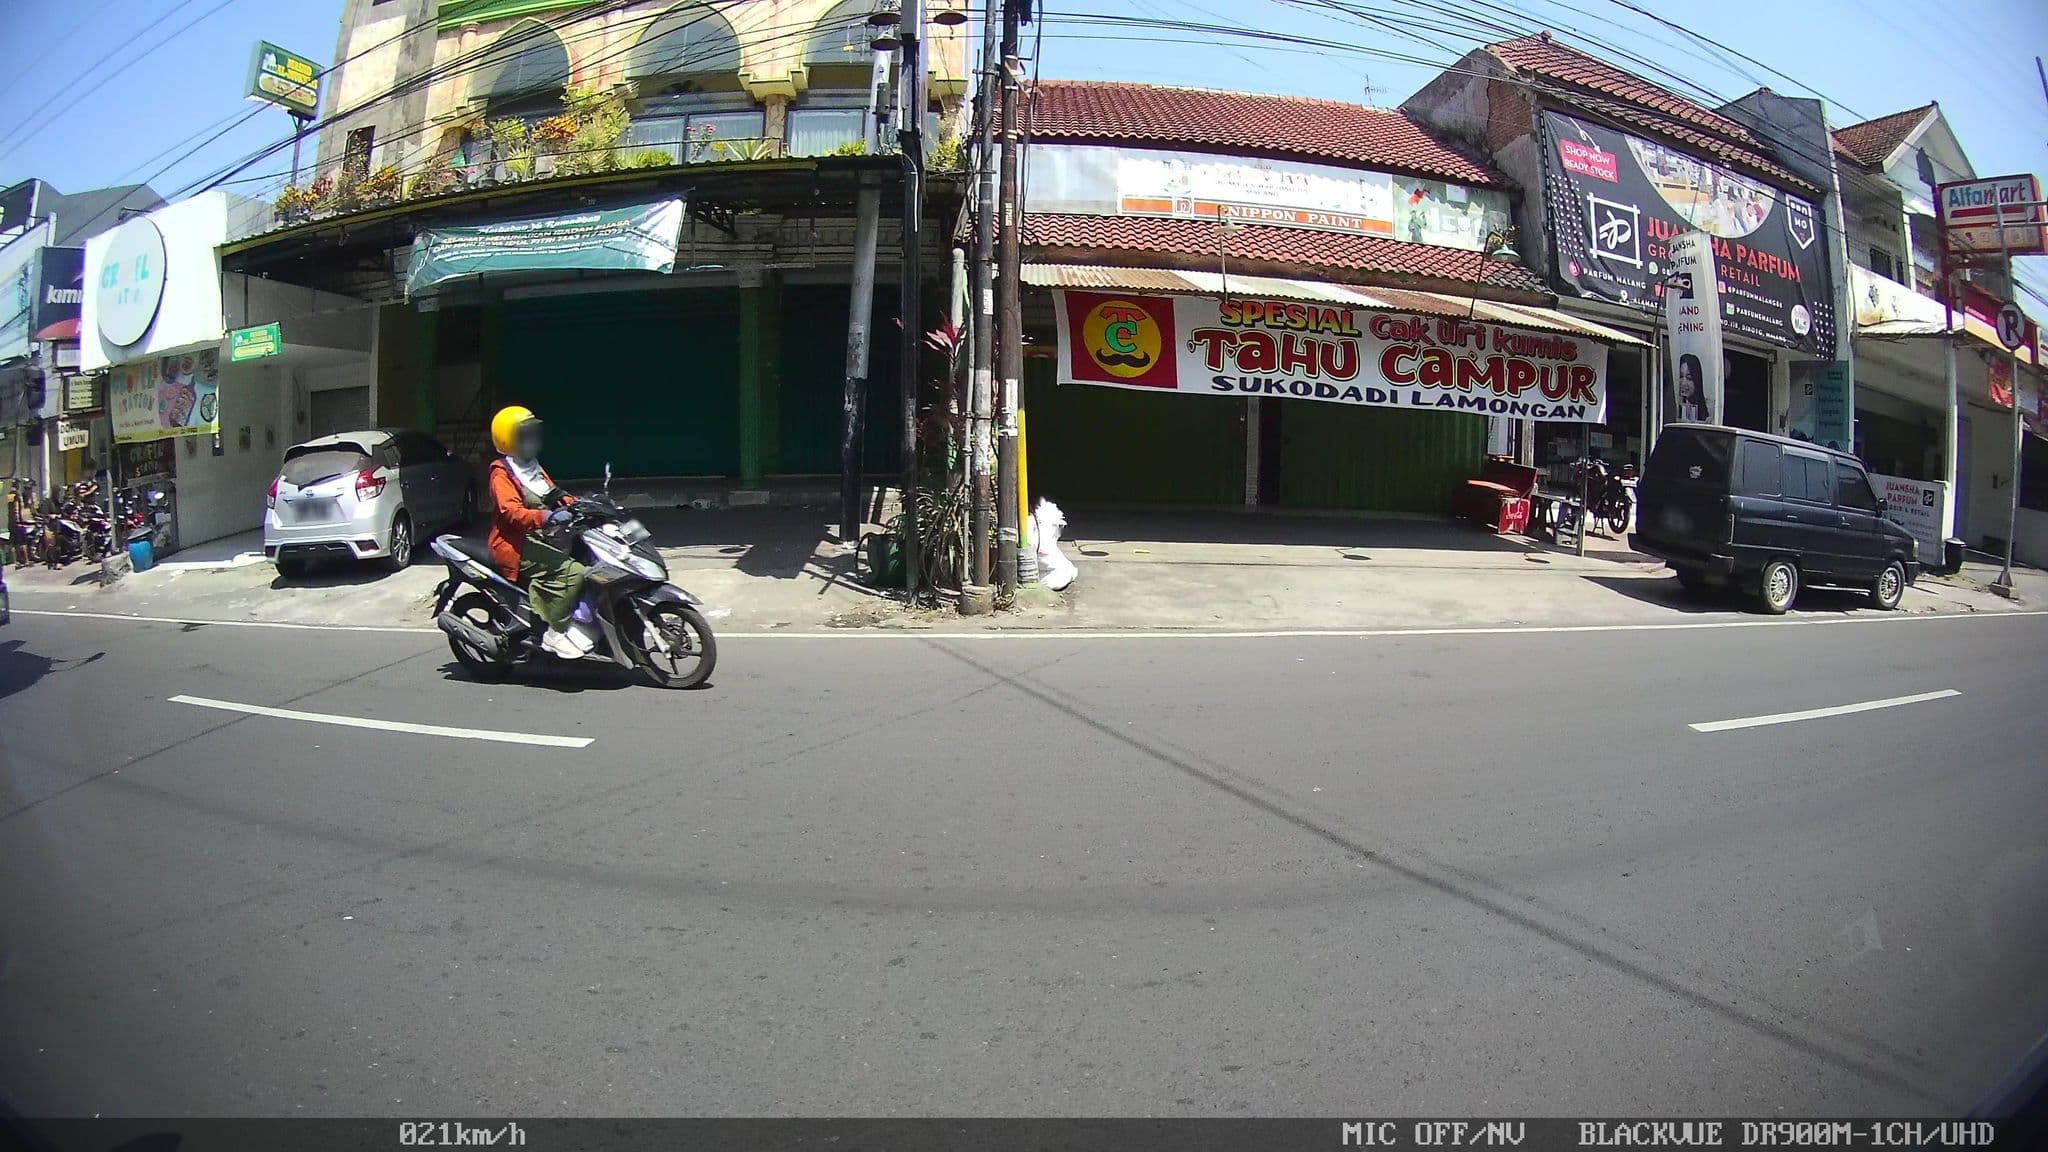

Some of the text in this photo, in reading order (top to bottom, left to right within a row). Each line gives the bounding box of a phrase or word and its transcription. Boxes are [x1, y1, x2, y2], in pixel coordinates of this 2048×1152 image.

[1565, 145, 1610, 165] SHOP NOW
[1564, 159, 1615, 179] READY STOCK
[1226, 206, 1297, 222] NIPPON
[1307, 213, 1363, 229] PAINT
[1736, 243, 1801, 283] PARFUM
[1583, 267, 1647, 290] PARFUM MALANG
[1720, 264, 1761, 287] RETAIL
[46, 284, 83, 304] kimi
[1219, 300, 1363, 338] SPESIAL
[1211, 376, 1586, 419] SUKODADI LAMONGAN
[1886, 482, 1920, 495] JUANSHA
[1887, 493, 1918, 505] PARFUM
